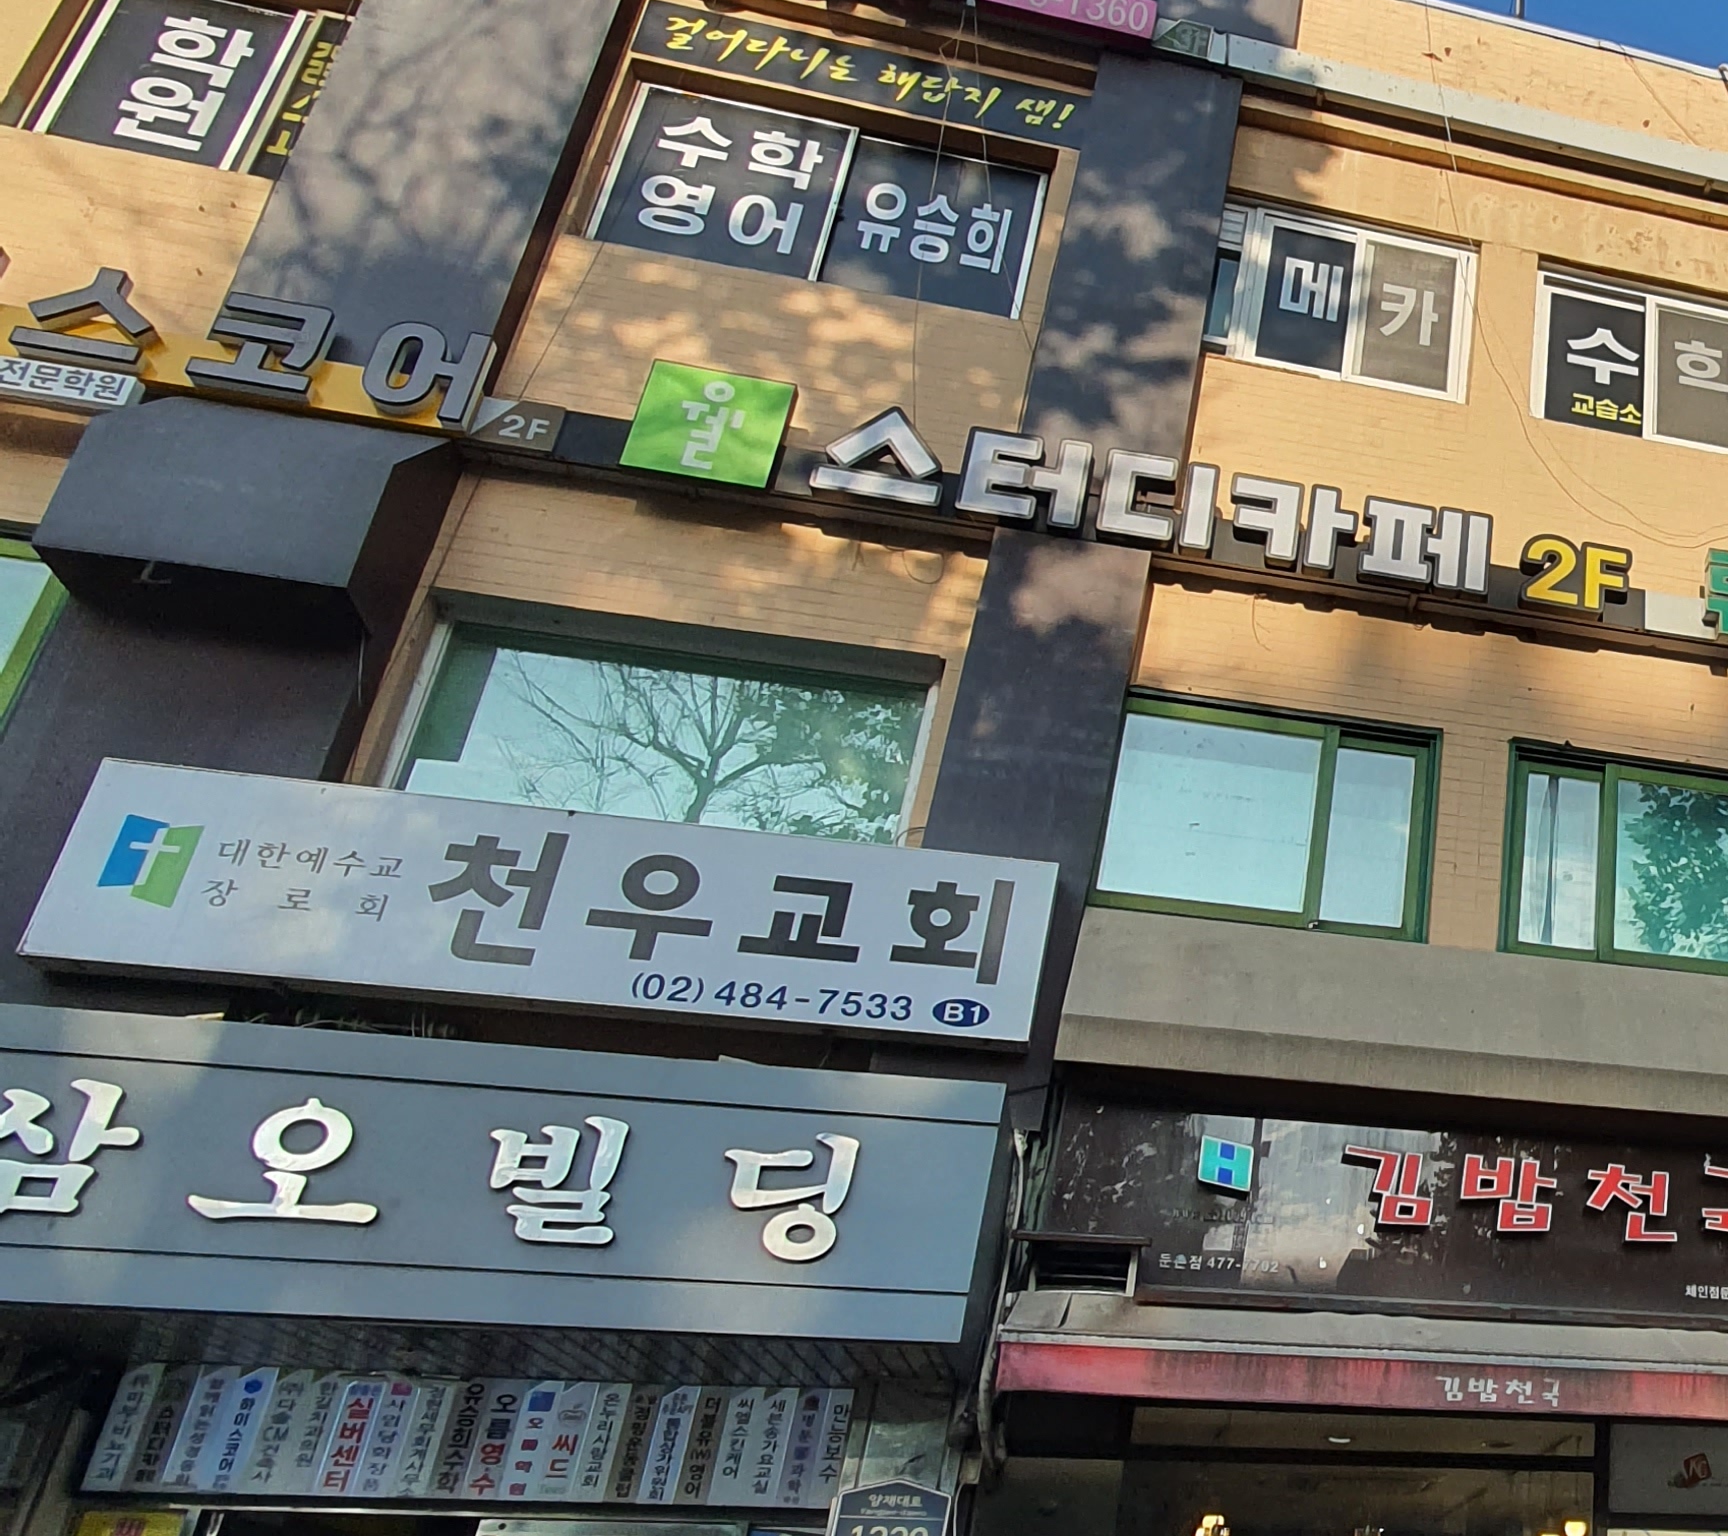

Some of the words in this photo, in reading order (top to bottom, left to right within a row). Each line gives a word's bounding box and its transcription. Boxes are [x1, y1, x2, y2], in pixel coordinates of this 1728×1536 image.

[114, 16, 255, 151] 학원
[655, 116, 824, 190] 수학
[636, 173, 804, 255] 영어
[856, 182, 1013, 274] 유승희
[1278, 256, 1439, 347] 메카
[500, 414, 550, 442] 2F
[1571, 392, 1642, 426] 교습소
[811, 406, 1494, 596] 스터디카페
[1520, 535, 1632, 612] 2F
[218, 837, 404, 880] 대한예수교
[428, 832, 1016, 986] 천우교회
[714, 981, 913, 1021] 484-7533
[943, 1000, 983, 1026] B1
[1435, 1375, 1561, 1408] 김밥천국
[322, 1397, 375, 1494] 실버센터
